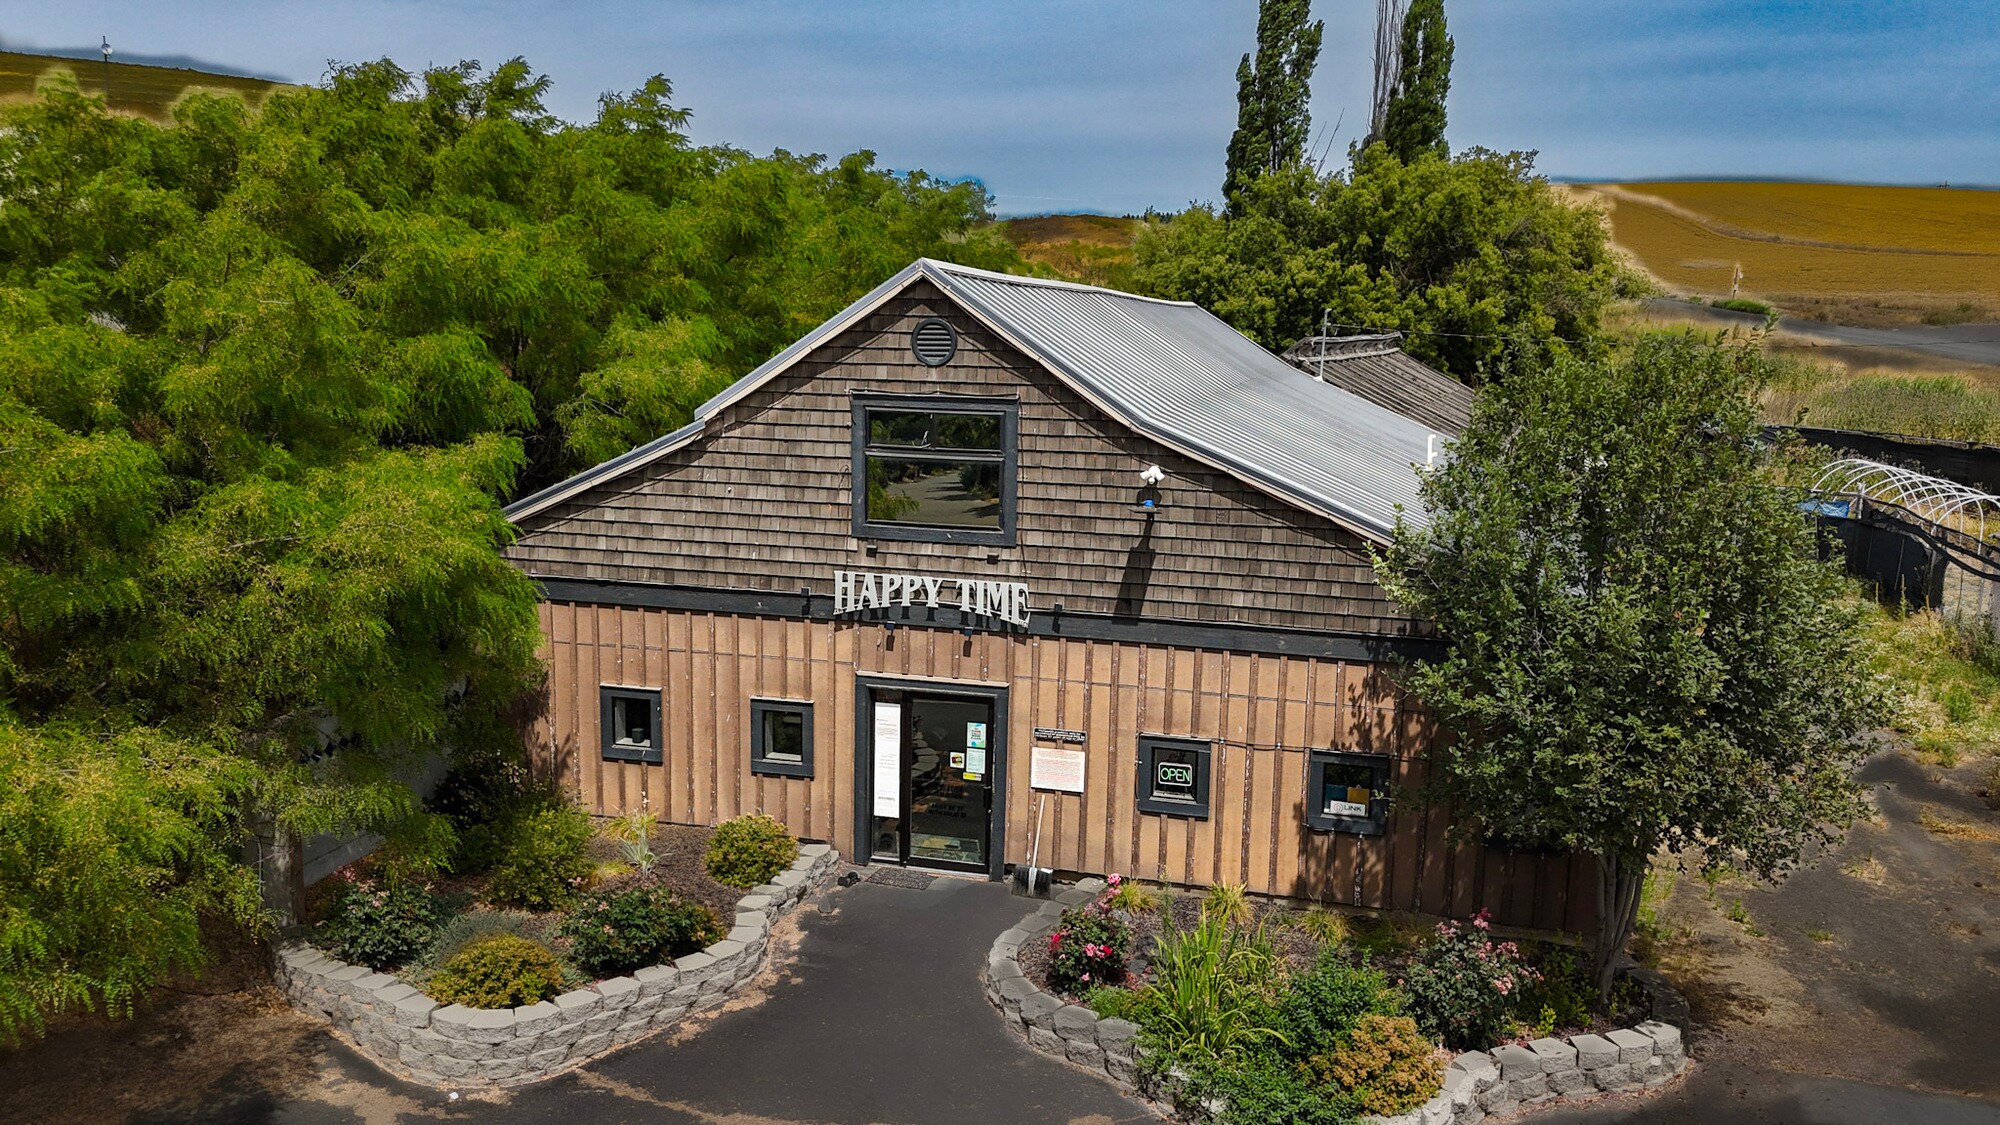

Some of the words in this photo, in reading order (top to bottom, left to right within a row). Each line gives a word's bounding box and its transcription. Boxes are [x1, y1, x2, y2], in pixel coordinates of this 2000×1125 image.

[833, 570, 943, 615] HAPPY
[956, 578, 1031, 628] TIME
[1160, 767, 1191, 782] OPEN
